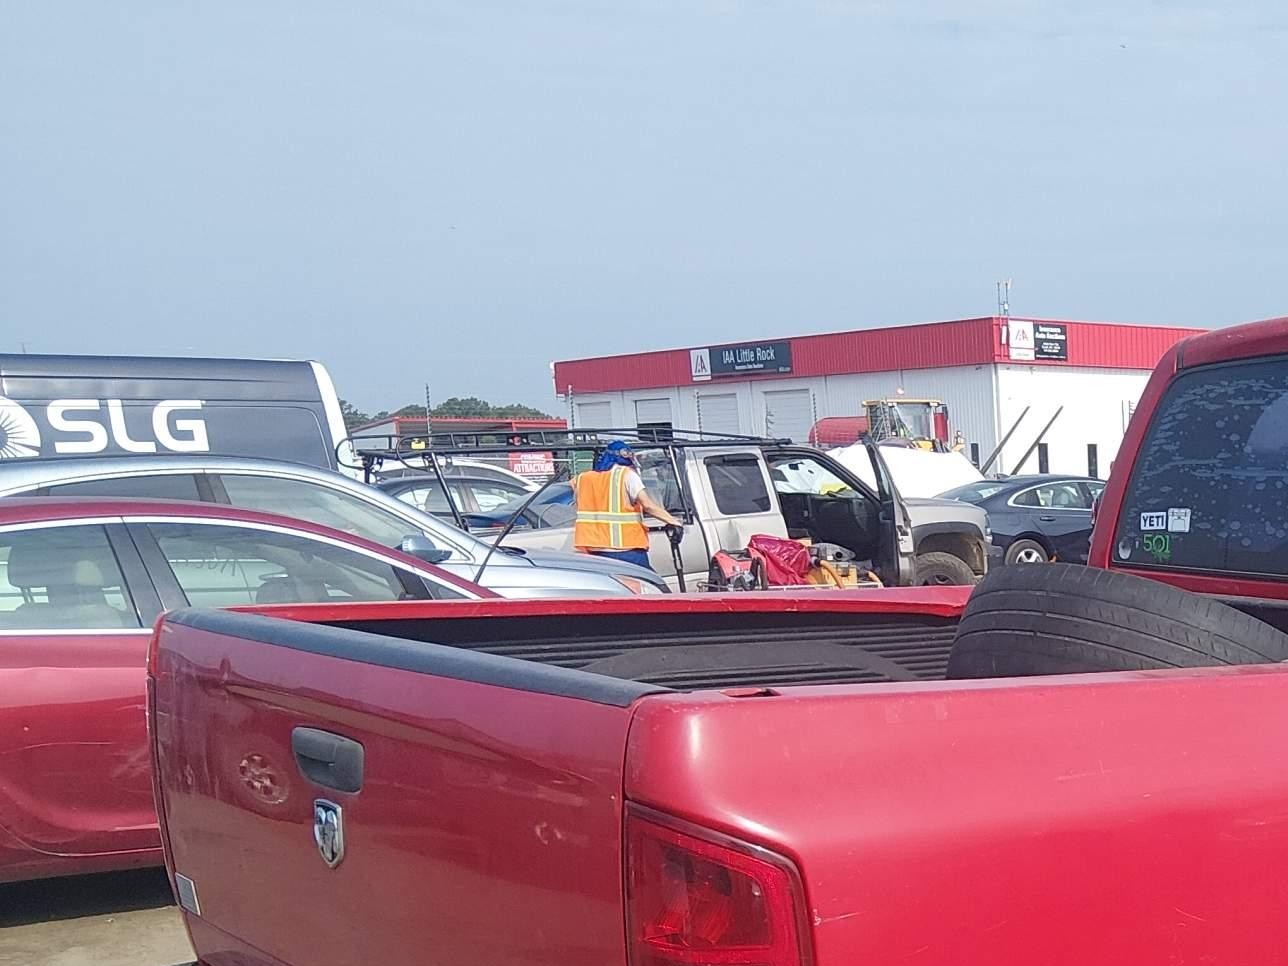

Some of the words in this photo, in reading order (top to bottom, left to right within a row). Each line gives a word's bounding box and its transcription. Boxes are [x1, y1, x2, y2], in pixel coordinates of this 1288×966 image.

[722, 350, 735, 364] IAA
[736, 348, 755, 362] Little
[756, 346, 776, 360] Rock
[47, 399, 210, 453] SLG
[1142, 515, 1165, 528] YETI
[1143, 533, 1171, 554] 501
